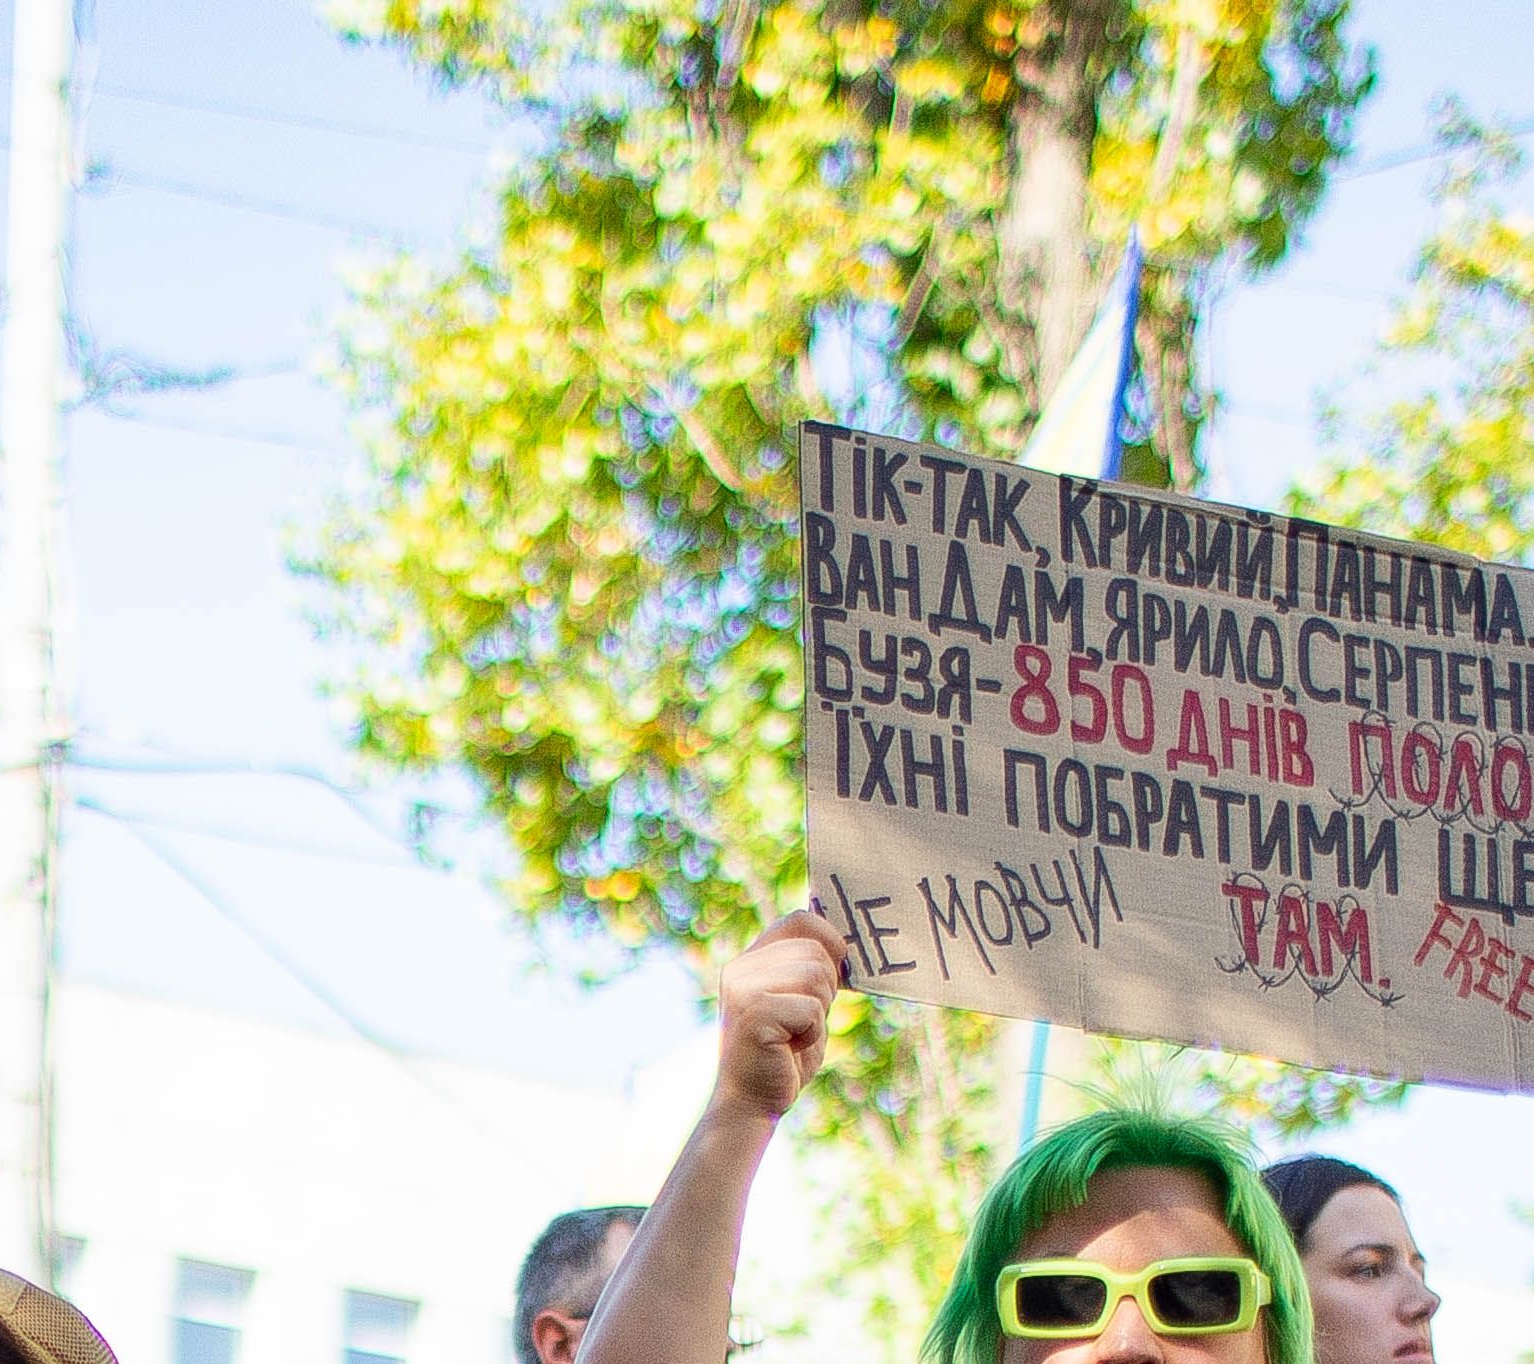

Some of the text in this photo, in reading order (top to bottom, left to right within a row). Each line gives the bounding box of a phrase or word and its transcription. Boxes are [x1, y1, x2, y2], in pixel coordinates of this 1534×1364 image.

[1009, 643, 1155, 755] 850
[1003, 748, 1399, 896] ПОБРАТИМИ
[917, 845, 1124, 981] МОВЧИ
